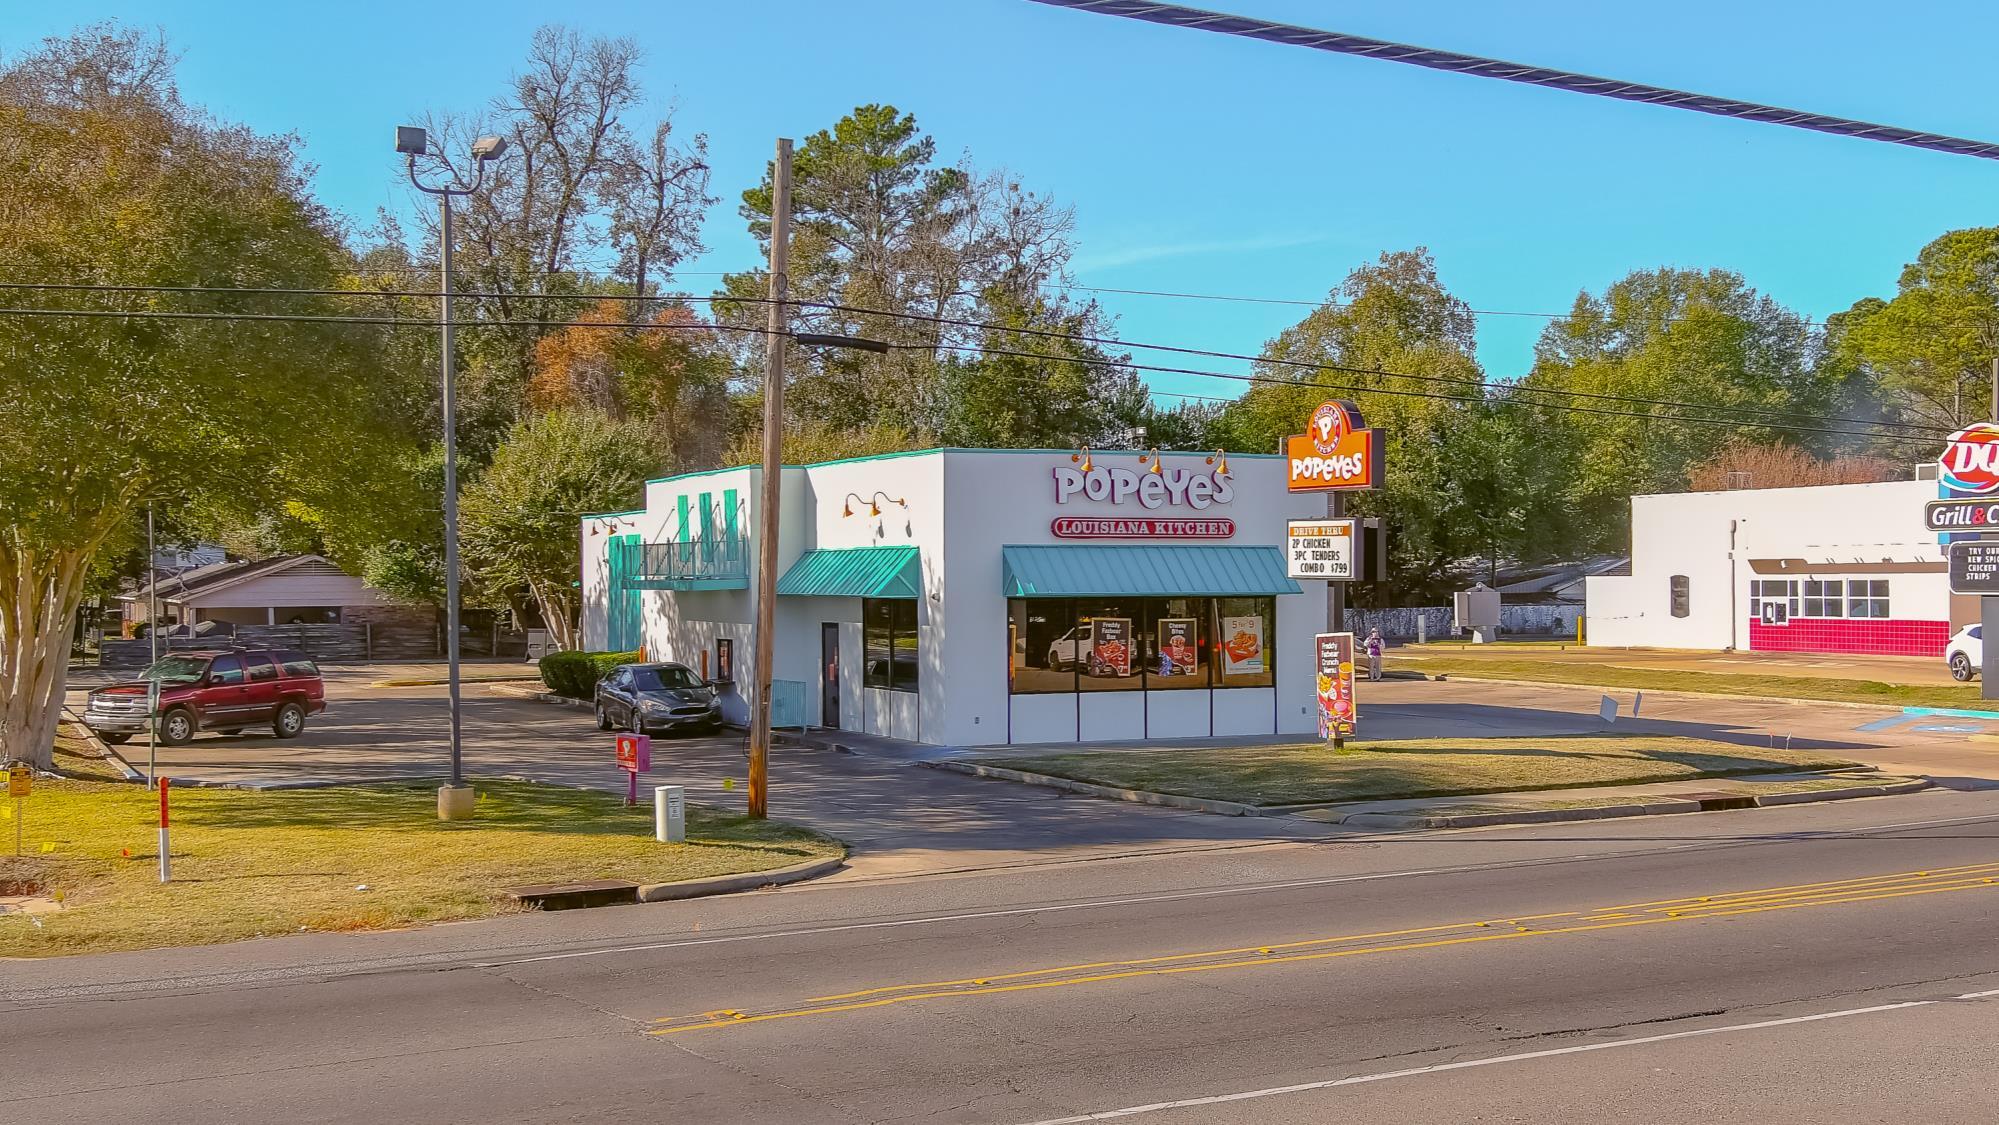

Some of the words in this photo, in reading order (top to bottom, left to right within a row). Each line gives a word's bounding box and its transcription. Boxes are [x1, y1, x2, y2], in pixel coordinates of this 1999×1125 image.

[1318, 416, 1333, 441] P
[1953, 441, 1999, 476] DQ
[1061, 521, 1150, 535] LOUISIANA
[1154, 522, 1231, 536] KITCHEN
[1293, 527, 1319, 536] DRIVE
[1321, 526, 1344, 535] THRU
[1303, 538, 1331, 548] CHICKEN
[1294, 550, 1307, 560] 3PC
[1311, 550, 1340, 561] TENDERS
[1968, 547, 1982, 555] TRY
[1968, 555, 1982, 563] NEW
[1300, 563, 1325, 573] COMBO
[1968, 564, 1997, 572] CHICKEN
